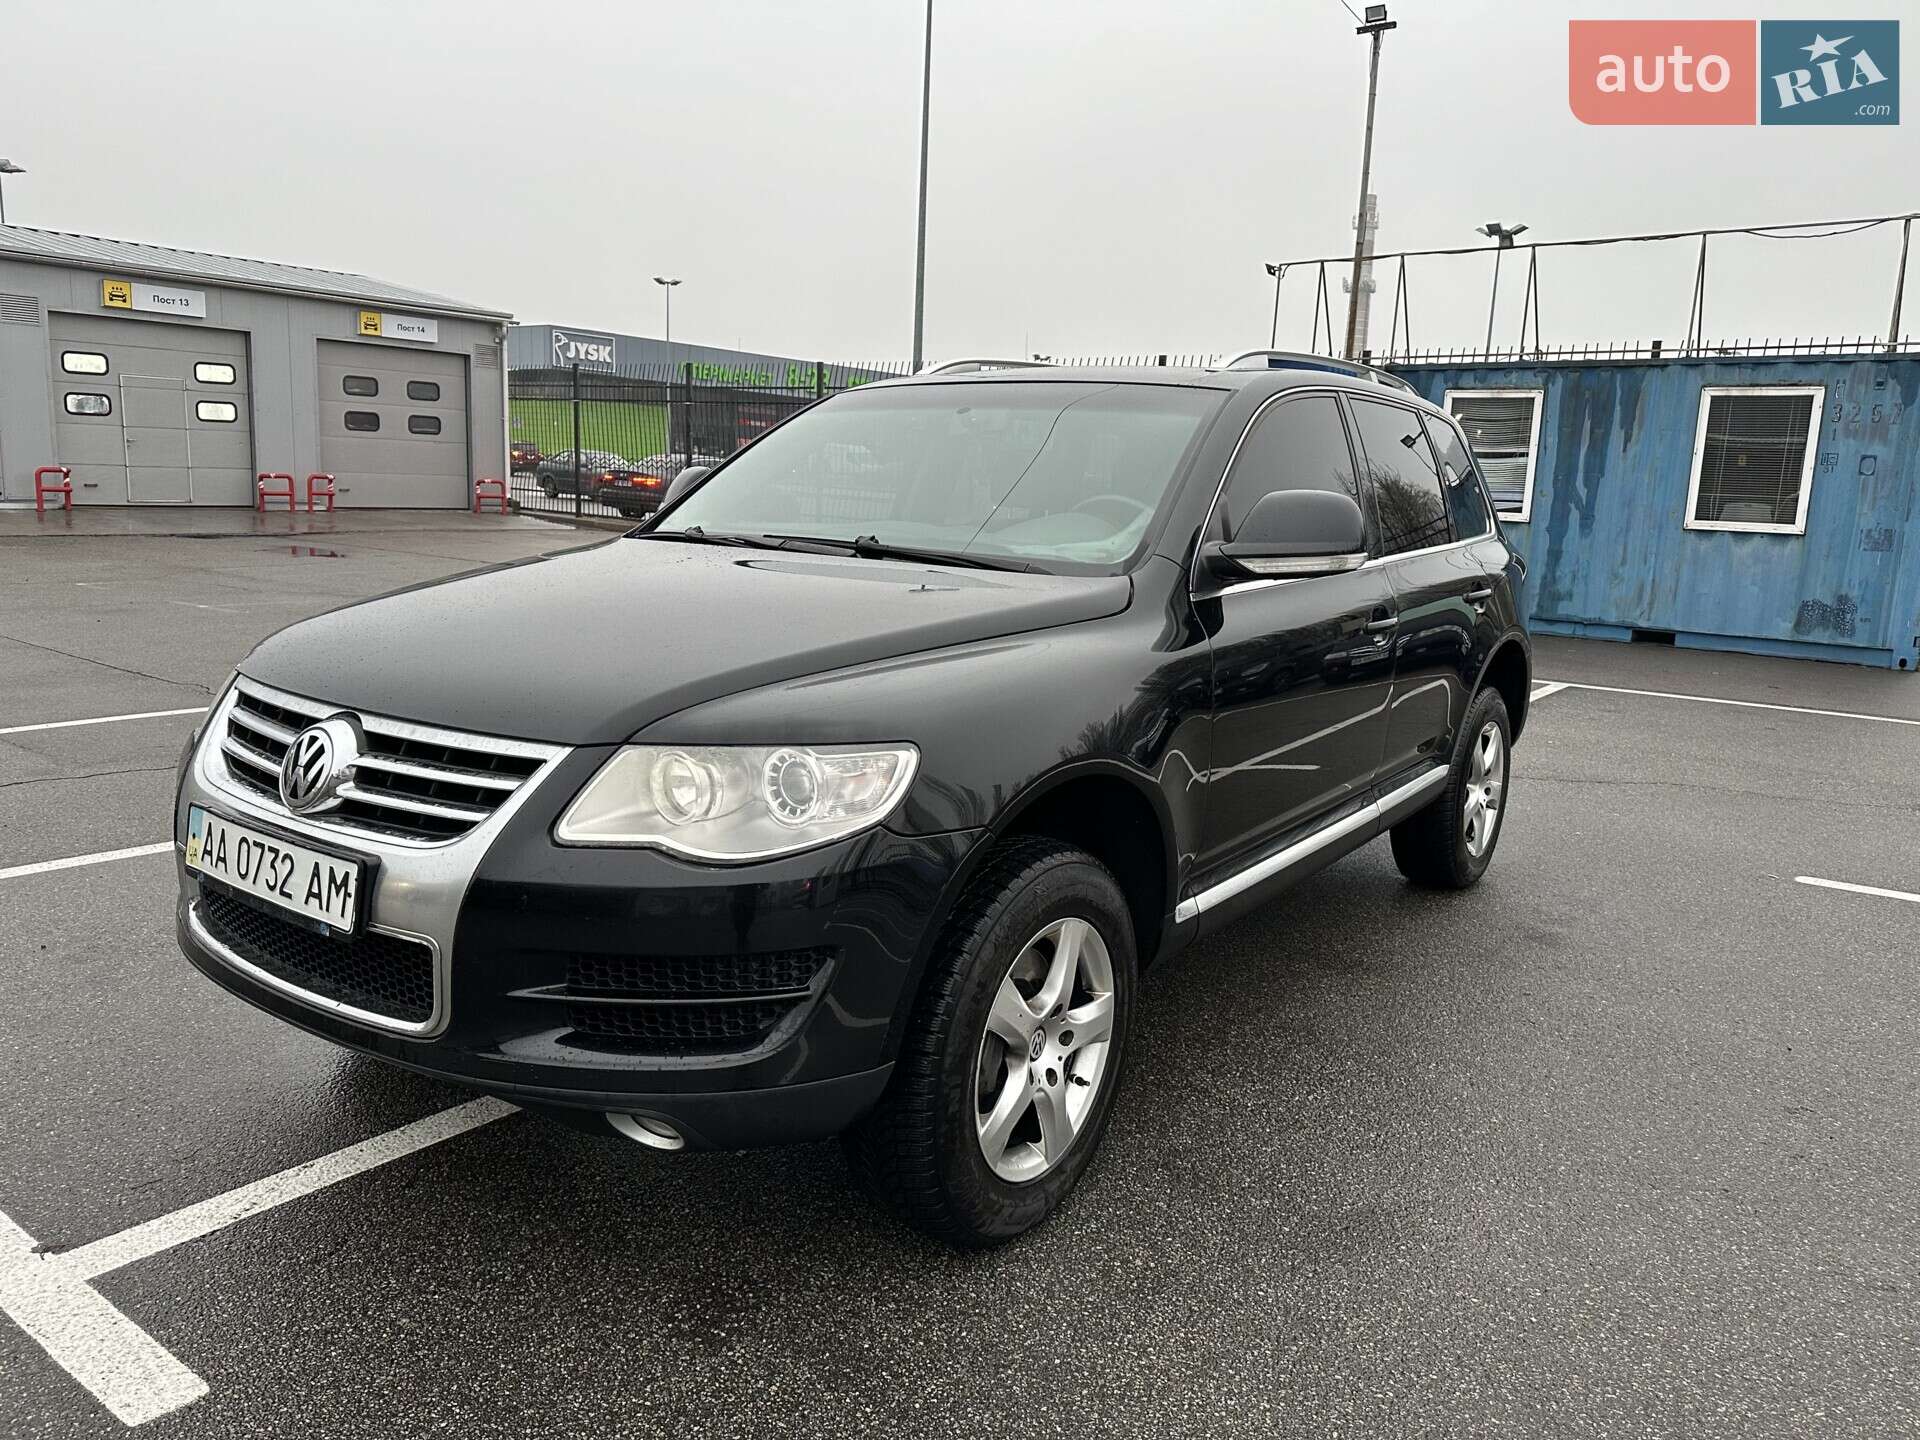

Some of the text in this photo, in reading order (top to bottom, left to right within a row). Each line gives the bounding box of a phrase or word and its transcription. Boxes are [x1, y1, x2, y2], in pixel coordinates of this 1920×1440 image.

[152, 294, 190, 307] Пост 13
[397, 323, 415, 333] Пост
[566, 341, 612, 363] JYSK
[201, 821, 352, 918] AA 0732 AM
